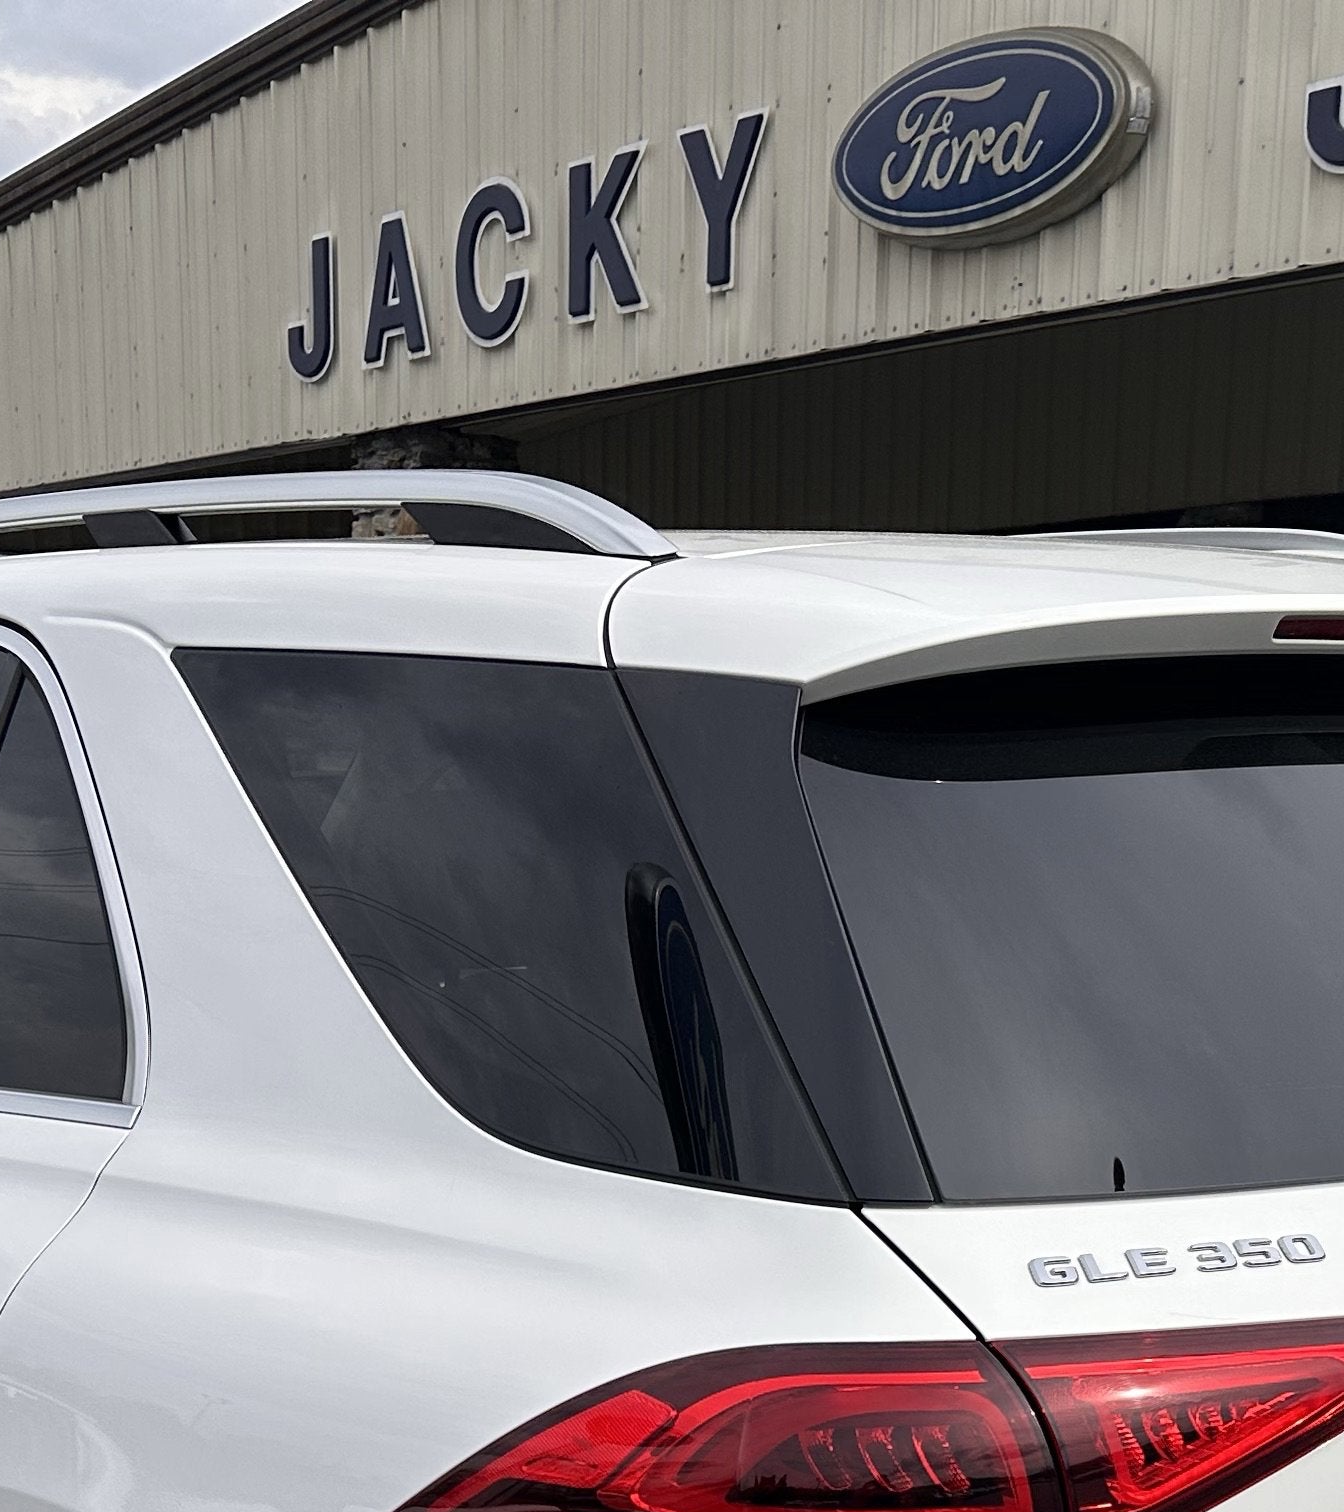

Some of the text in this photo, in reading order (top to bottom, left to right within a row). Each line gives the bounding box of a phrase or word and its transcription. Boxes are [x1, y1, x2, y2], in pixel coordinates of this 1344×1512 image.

[880, 76, 1051, 200] Ford
[287, 105, 770, 382] JACKY
[1028, 1233, 1326, 1287] GLE 350
